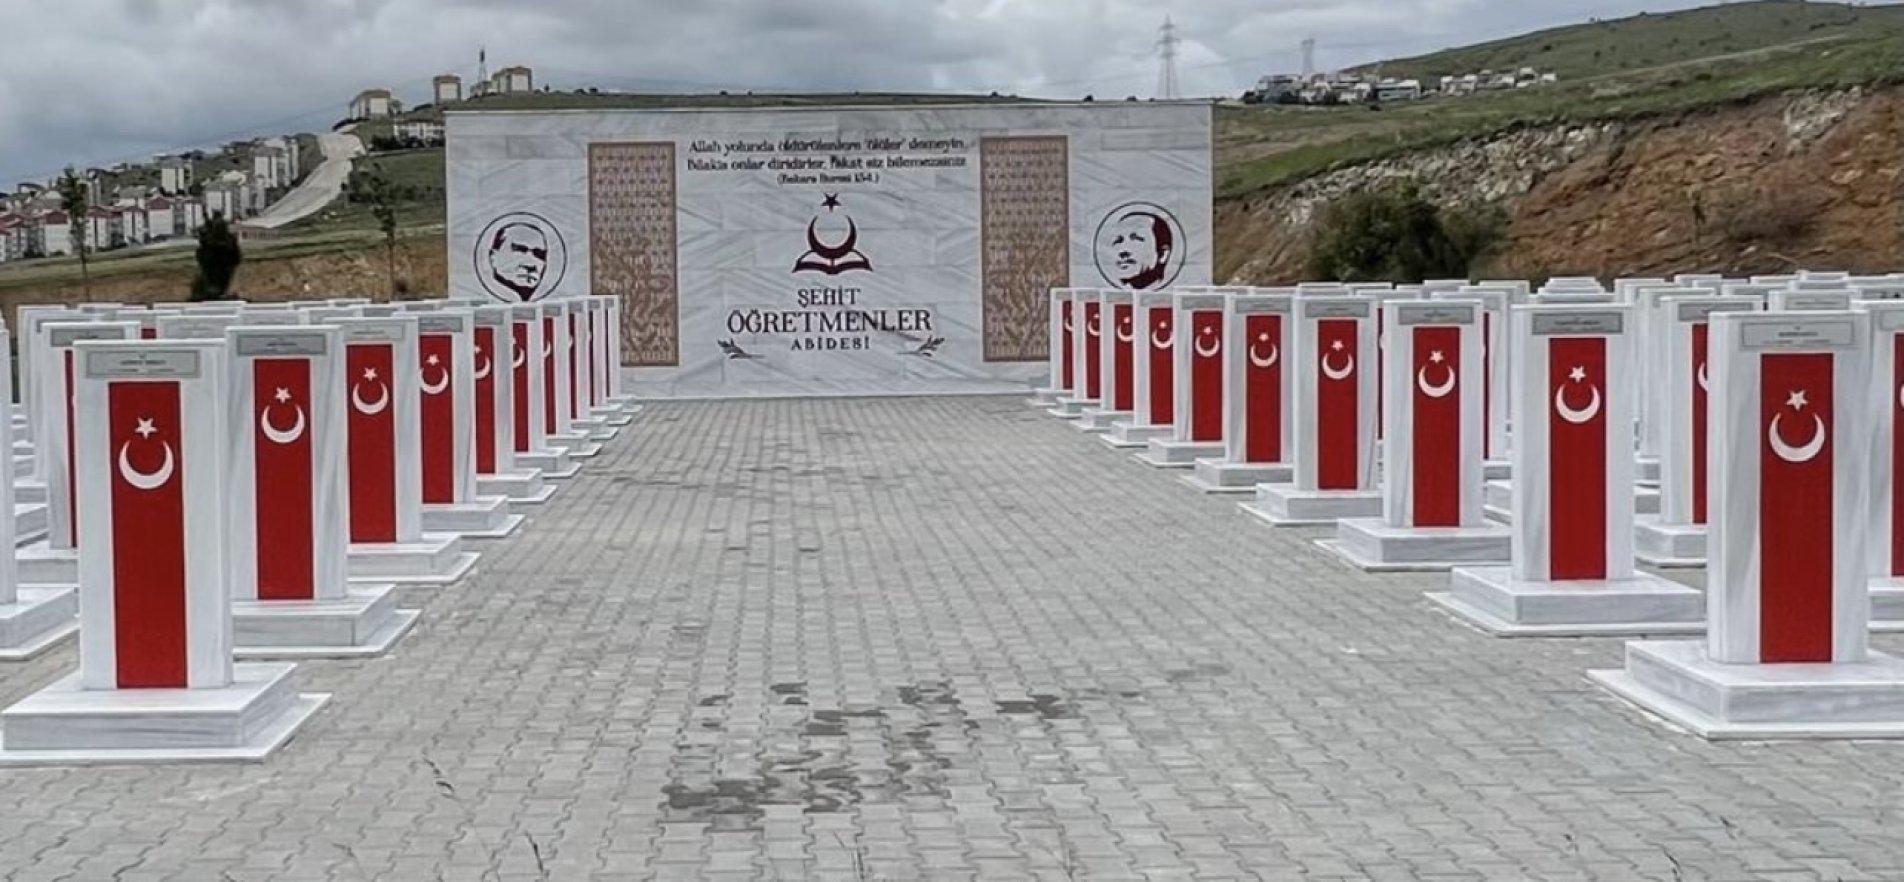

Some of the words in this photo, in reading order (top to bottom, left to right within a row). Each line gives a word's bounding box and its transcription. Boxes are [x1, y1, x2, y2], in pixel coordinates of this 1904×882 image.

[689, 140, 720, 152] Allah
[731, 157, 764, 169] onlar
[797, 285, 861, 308] ŞEHİT
[727, 308, 932, 333] ÖĞRETMENLER
